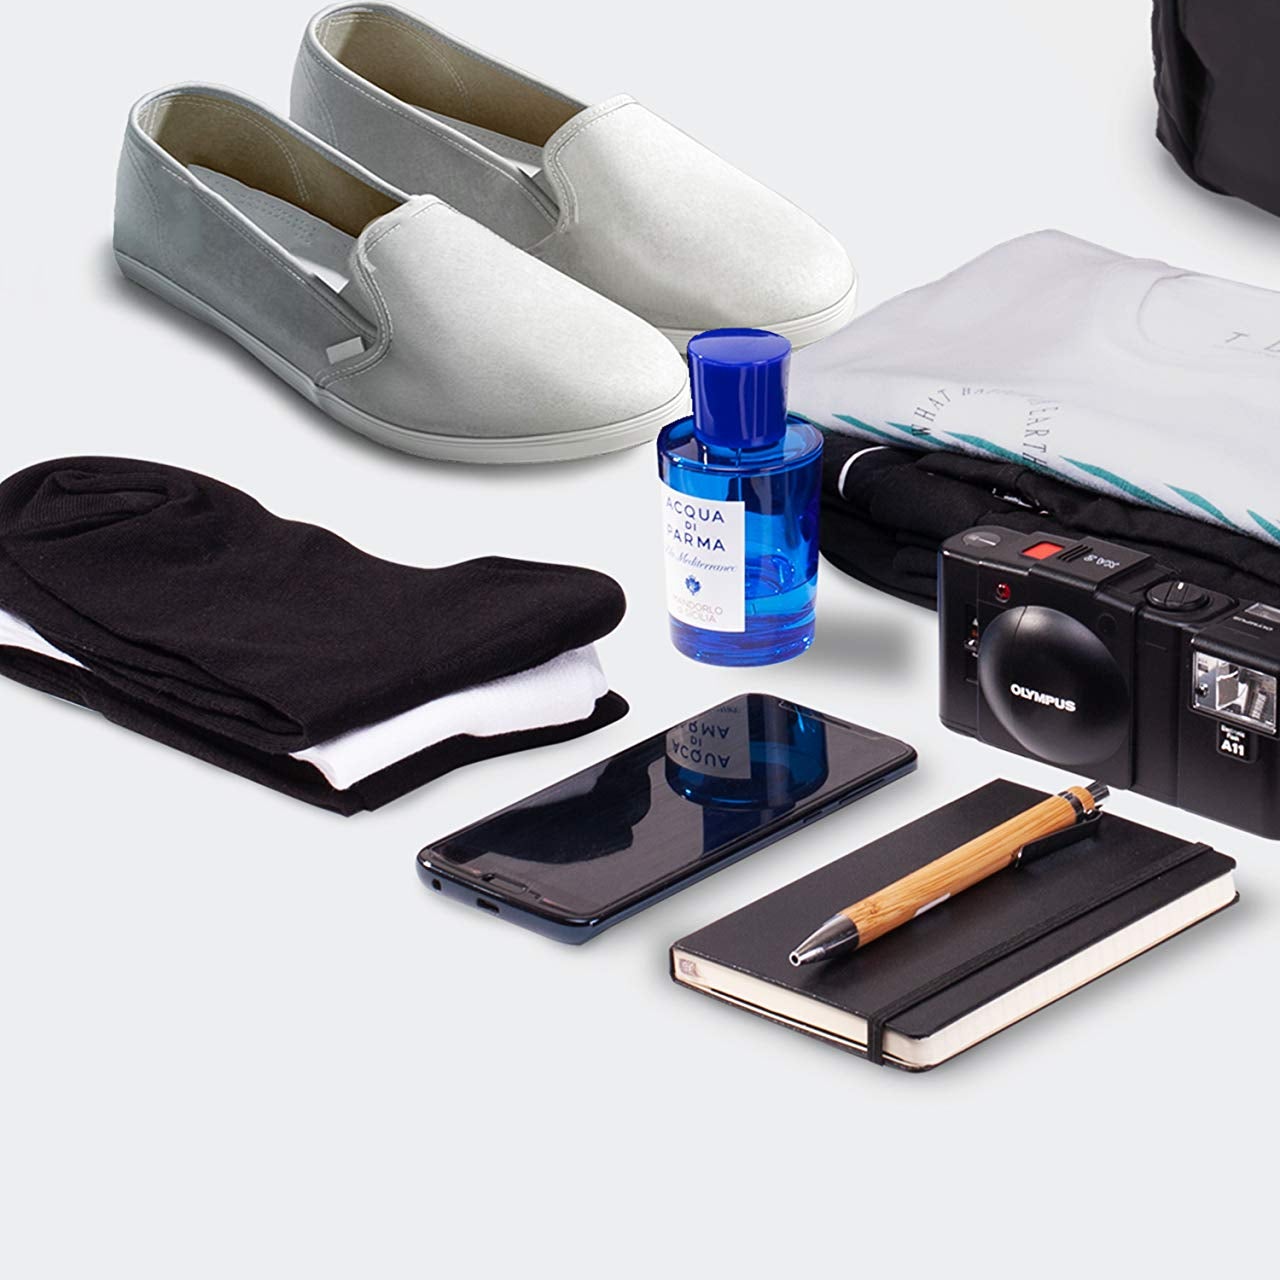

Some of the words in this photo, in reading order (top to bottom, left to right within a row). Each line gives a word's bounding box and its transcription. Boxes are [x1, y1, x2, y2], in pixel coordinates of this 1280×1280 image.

[911, 388, 952, 436] WHAT
[666, 497, 726, 523] ACQUA
[685, 521, 697, 532] DI
[1010, 683, 1077, 712] OLYMPUS
[1221, 739, 1244, 756] A11
